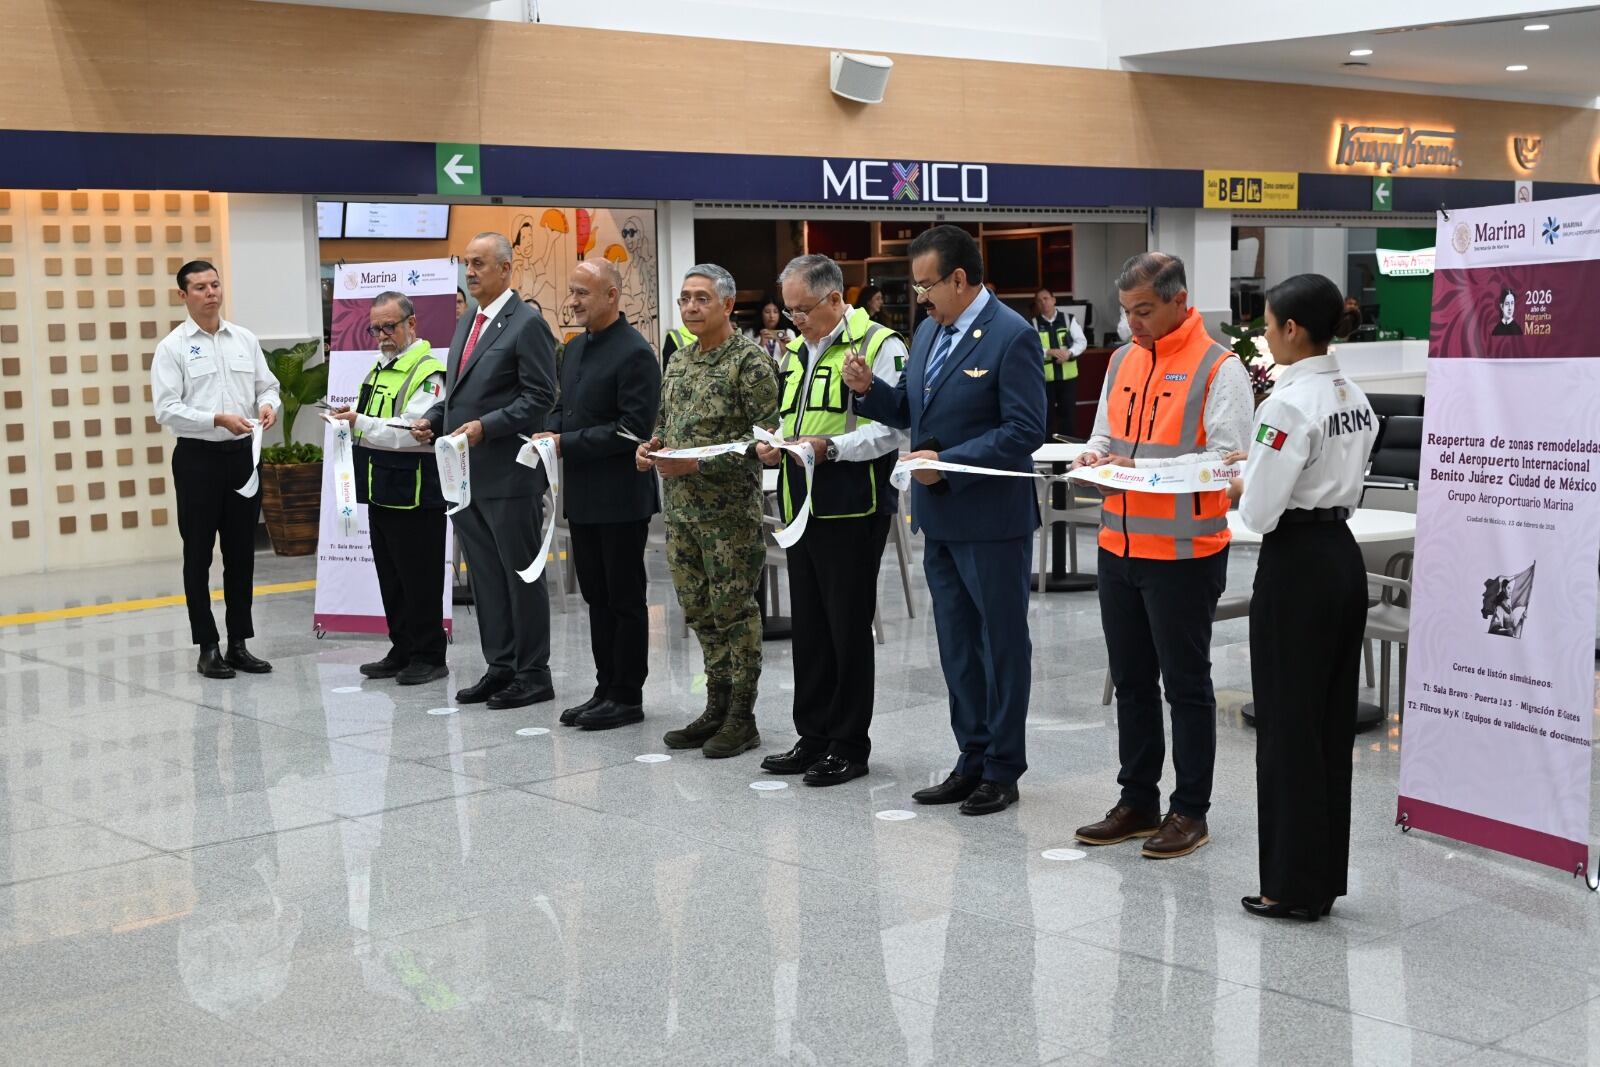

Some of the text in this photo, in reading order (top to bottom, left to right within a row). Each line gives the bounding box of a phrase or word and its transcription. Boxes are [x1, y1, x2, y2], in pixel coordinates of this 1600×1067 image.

[823, 159, 988, 202] MEXICO
[1219, 178, 1227, 201] B
[1474, 220, 1526, 242] Marina
[360, 272, 397, 284] Marina
[1525, 290, 1552, 305] 2026
[1525, 313, 1552, 322] Margarita
[1524, 323, 1551, 335] Maza
[1428, 433, 1600, 454] Reapertura de zonas remodeladas
[1440, 451, 1590, 472] del Aeropuerto Internacional
[1113, 471, 1144, 483] Marina
[1431, 469, 1597, 492] Benito Juárez Ciudad de México
[1448, 490, 1574, 511] Grupo Aeroportuario Marina
[1453, 663, 1553, 688] Cortes de listón simultáneos:
[1423, 683, 1432, 692] T1:
[1434, 684, 1447, 695] Sala
[1449, 688, 1468, 699] Bravo
[1474, 693, 1498, 705] Puerta
[1520, 702, 1555, 716] Migración
[1408, 700, 1419, 710] T2:
[1420, 703, 1441, 715] Filtros
[1443, 708, 1450, 716] M
[1450, 710, 1454, 719] y
[1454, 710, 1459, 718] K
[1494, 718, 1502, 727] de
[1504, 721, 1538, 734] validación
[1539, 727, 1547, 736] de
